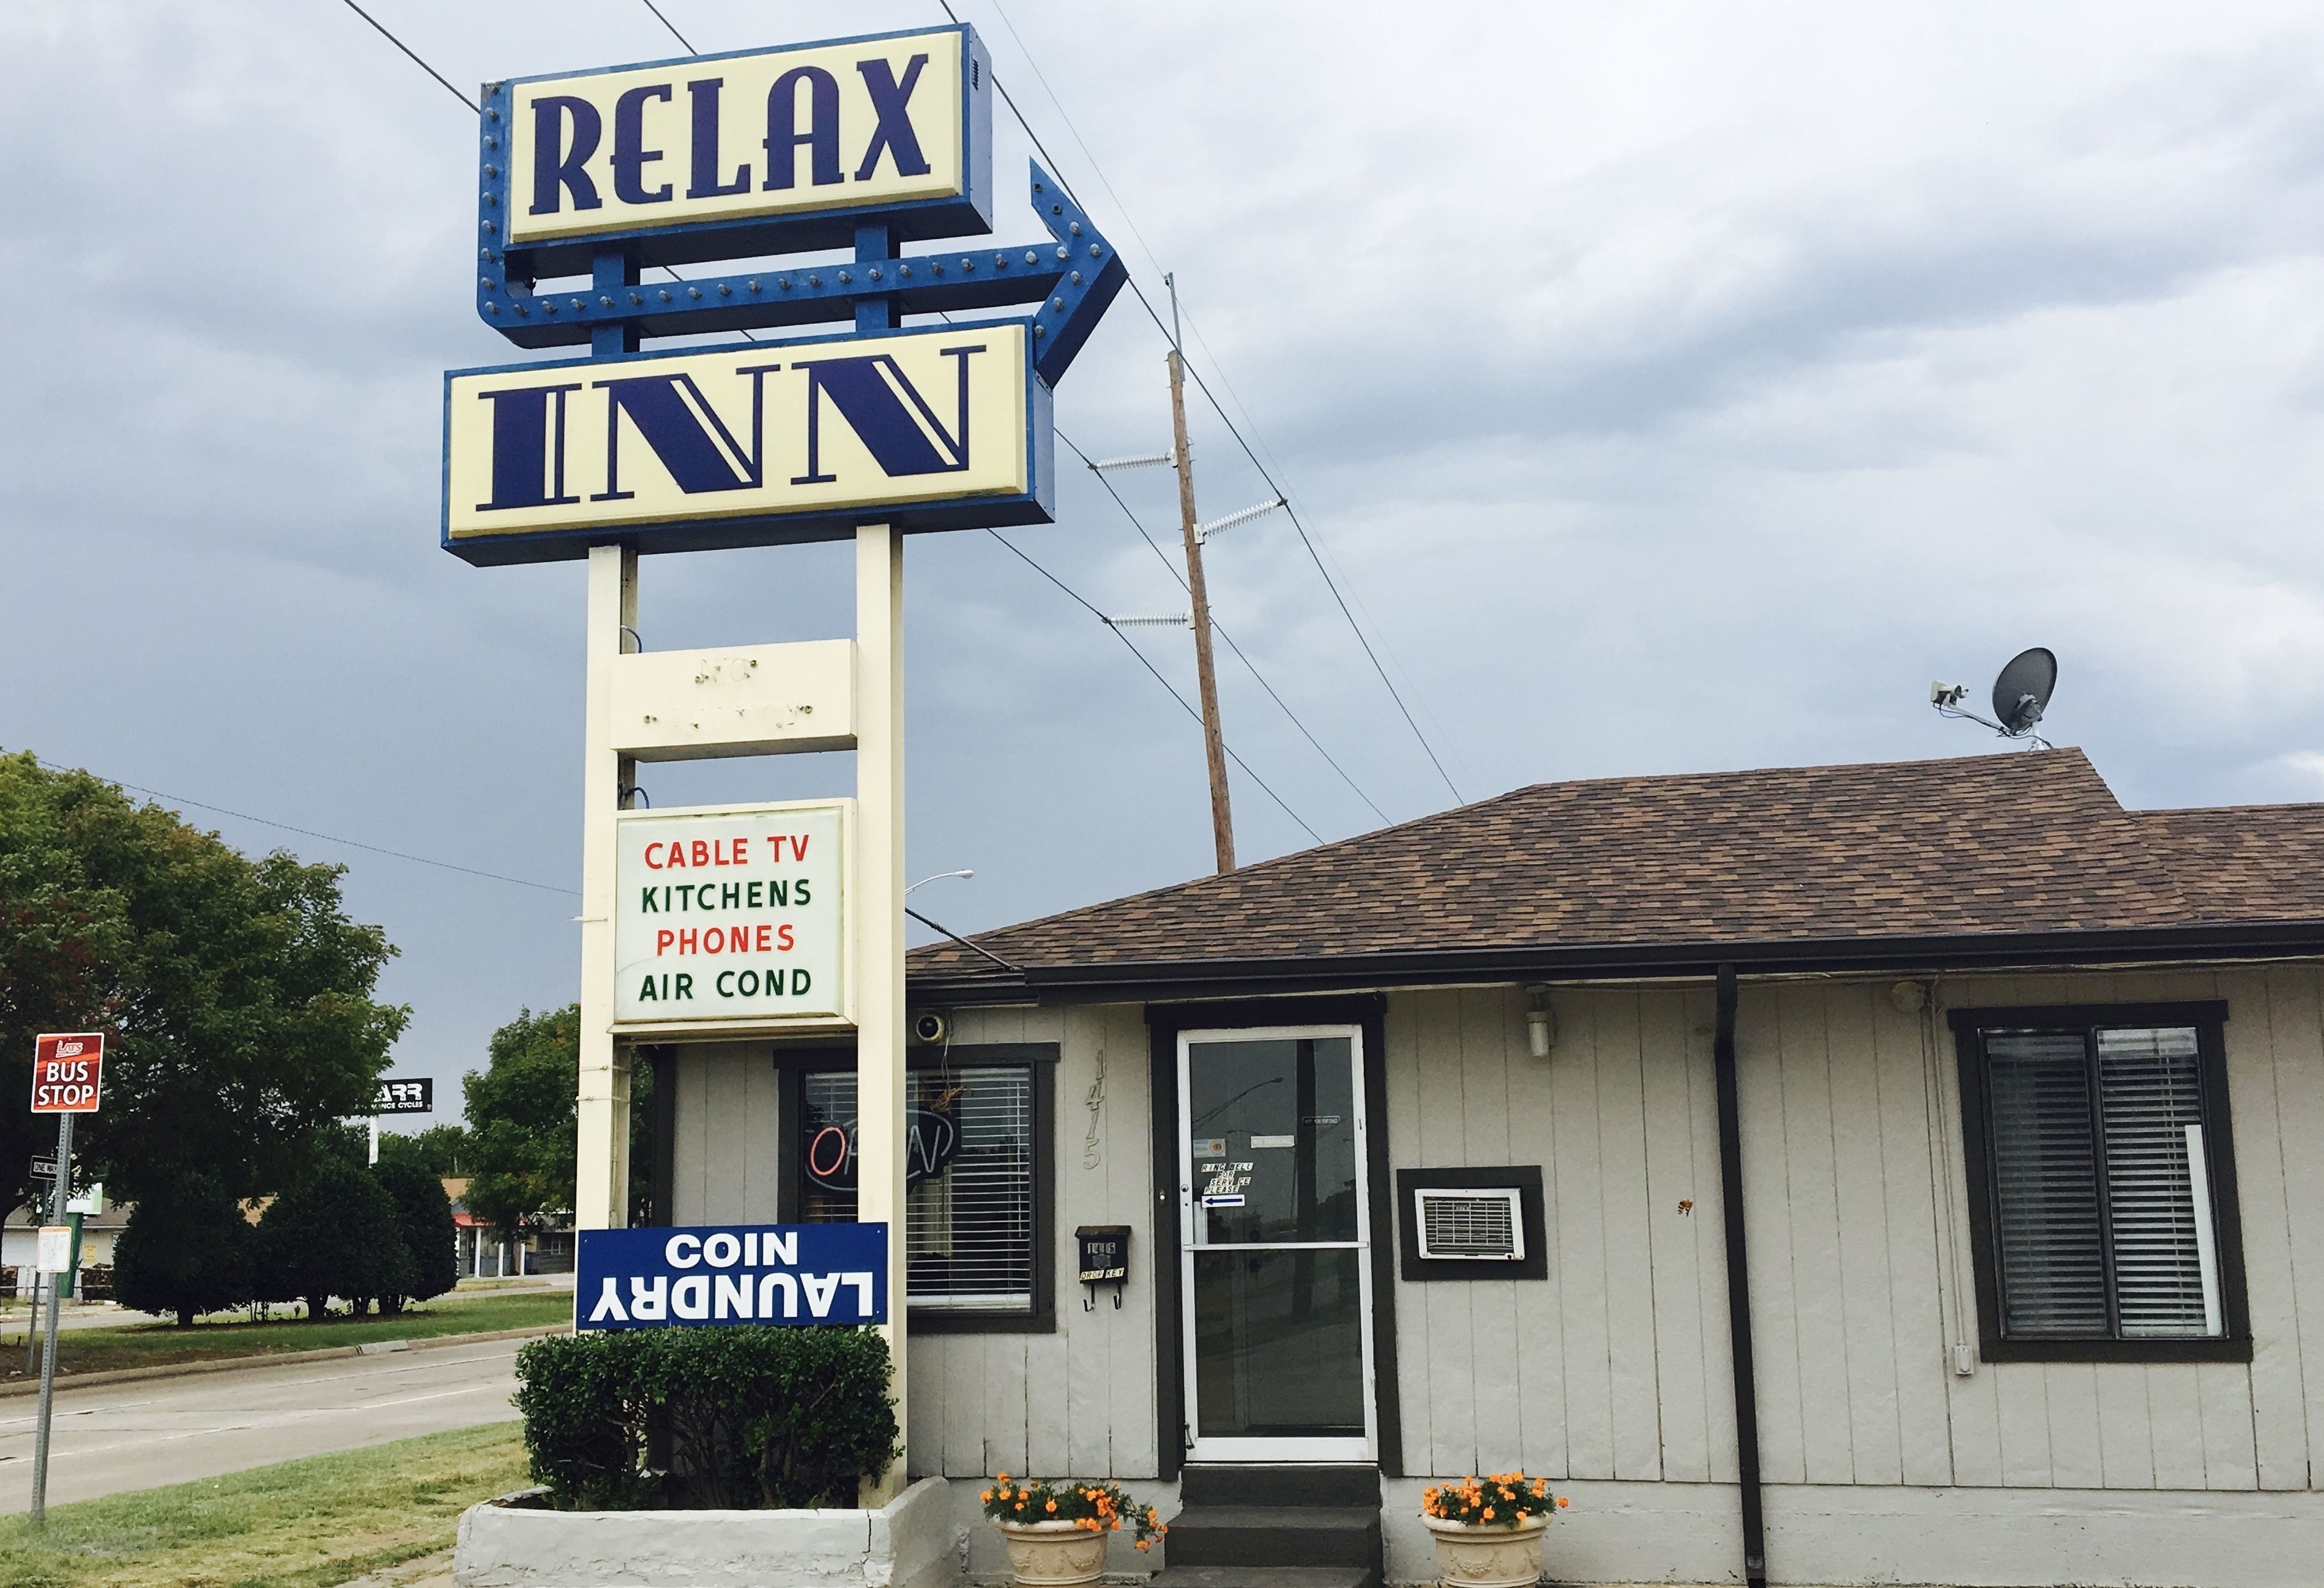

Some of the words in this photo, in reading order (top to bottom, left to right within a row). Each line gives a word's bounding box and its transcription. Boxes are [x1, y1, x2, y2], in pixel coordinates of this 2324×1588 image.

[529, 54, 931, 216] RELAX
[475, 344, 986, 511] INN
[644, 838, 748, 869] CABLE
[767, 834, 810, 863] TV
[642, 879, 811, 913] KITCHENS
[657, 924, 794, 956] PHONES
[639, 973, 693, 1001] AIR
[717, 969, 811, 997] COND
[56, 1040, 83, 1053] LATS
[46, 1061, 89, 1082] BUS
[38, 1085, 94, 1106] STOP
[35, 1163, 46, 1171] ONE
[665, 1232, 797, 1268] COIN
[1080, 1271, 1104, 1280] DROP
[1106, 1268, 1124, 1278] KEY
[589, 1272, 873, 1321] LAUNDRY
